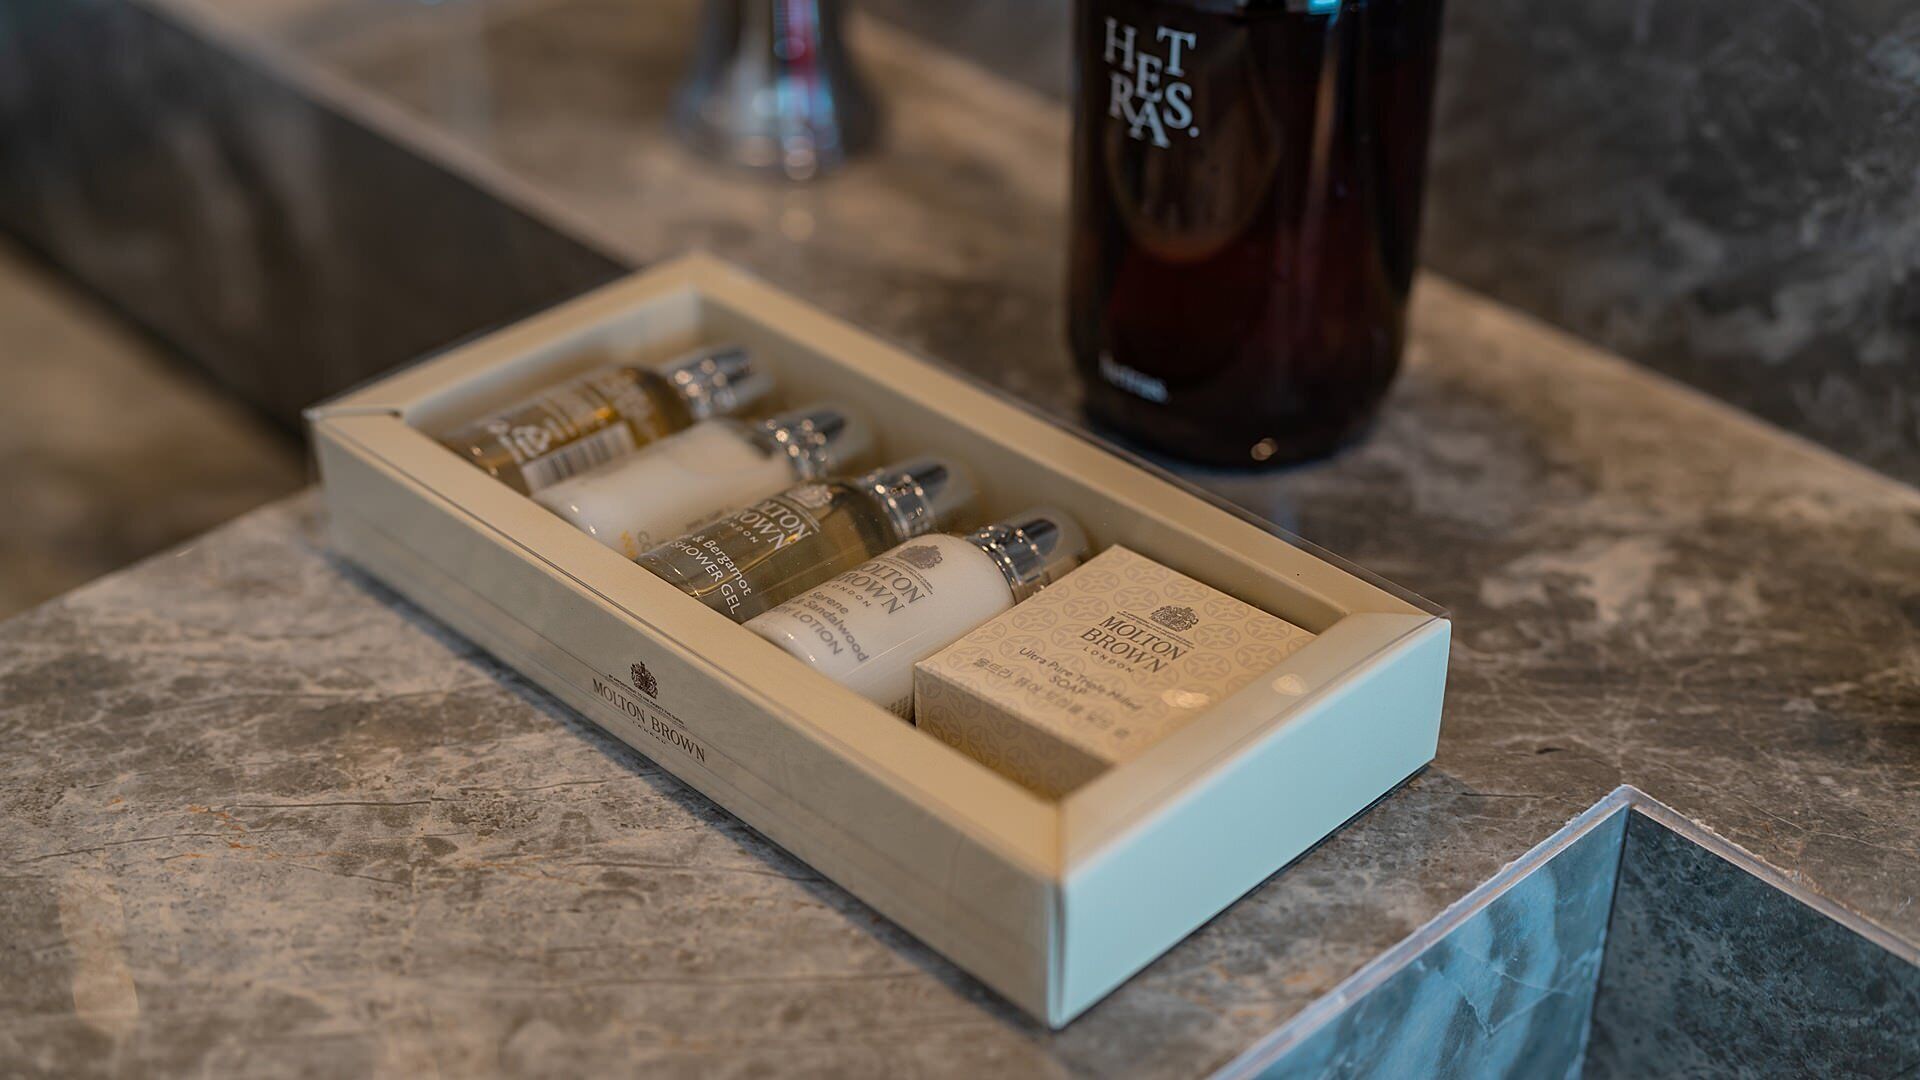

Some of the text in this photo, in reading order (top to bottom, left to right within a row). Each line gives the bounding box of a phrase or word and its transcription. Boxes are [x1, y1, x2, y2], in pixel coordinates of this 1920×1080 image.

[670, 541, 741, 615] SHOWER GEL
[702, 539, 752, 596] Bergamot
[858, 562, 925, 604] OLTON
[808, 591, 849, 615] Serene
[792, 610, 844, 655] LOTION
[803, 600, 870, 662] Sandalwood
[1080, 628, 1169, 673] BROWN
[1098, 615, 1188, 661] MOLTON
[1019, 647, 1047, 665] Ultra
[1083, 646, 1135, 673] LONDON
[592, 677, 647, 725] MOLTON
[650, 714, 706, 763] BROWN
